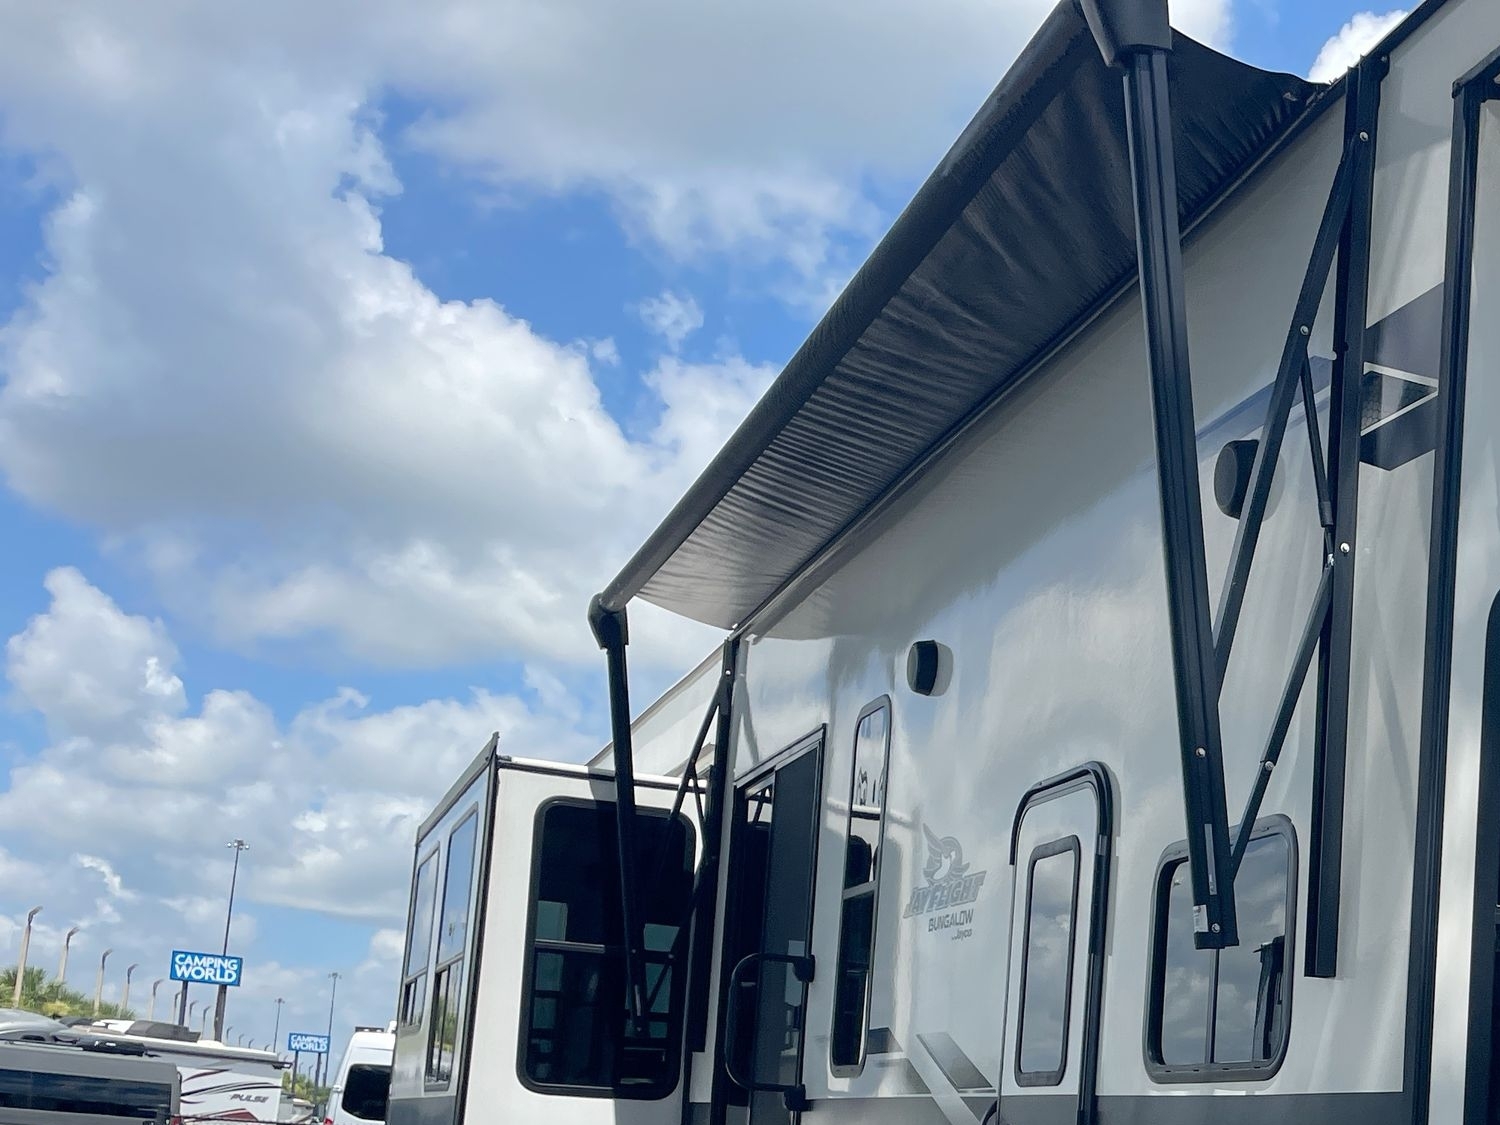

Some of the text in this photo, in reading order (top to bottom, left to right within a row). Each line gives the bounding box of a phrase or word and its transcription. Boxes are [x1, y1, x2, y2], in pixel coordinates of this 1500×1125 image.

[928, 909, 974, 932] BUNGALOW
[175, 954, 238, 971] CAMPING
[175, 964, 237, 982] WORLD
[290, 1034, 328, 1044] CAMPING
[291, 1041, 328, 1051] WORLD
[230, 1094, 270, 1103] PULSE
